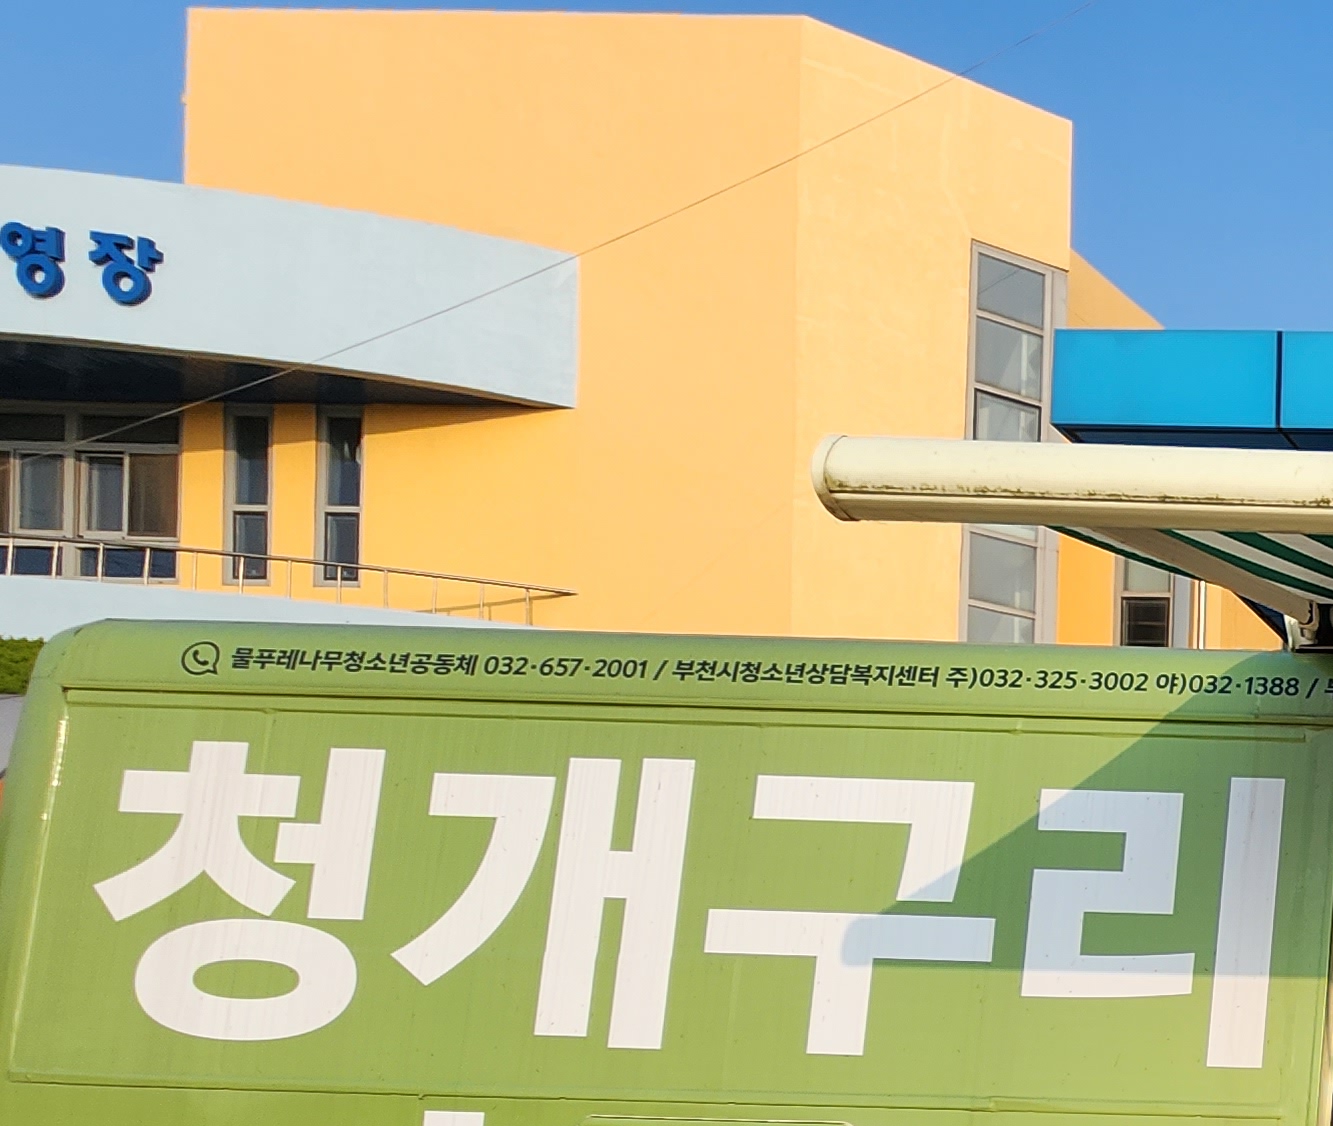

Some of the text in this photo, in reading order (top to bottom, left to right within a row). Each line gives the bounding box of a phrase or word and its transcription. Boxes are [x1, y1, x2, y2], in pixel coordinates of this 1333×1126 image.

[0, 221, 164, 306] 영장
[231, 647, 478, 676] 물푸레나무청소년공동체
[672, 660, 939, 689] 부천시청소년상담복지센터
[93, 741, 1286, 1069] 청개구리
